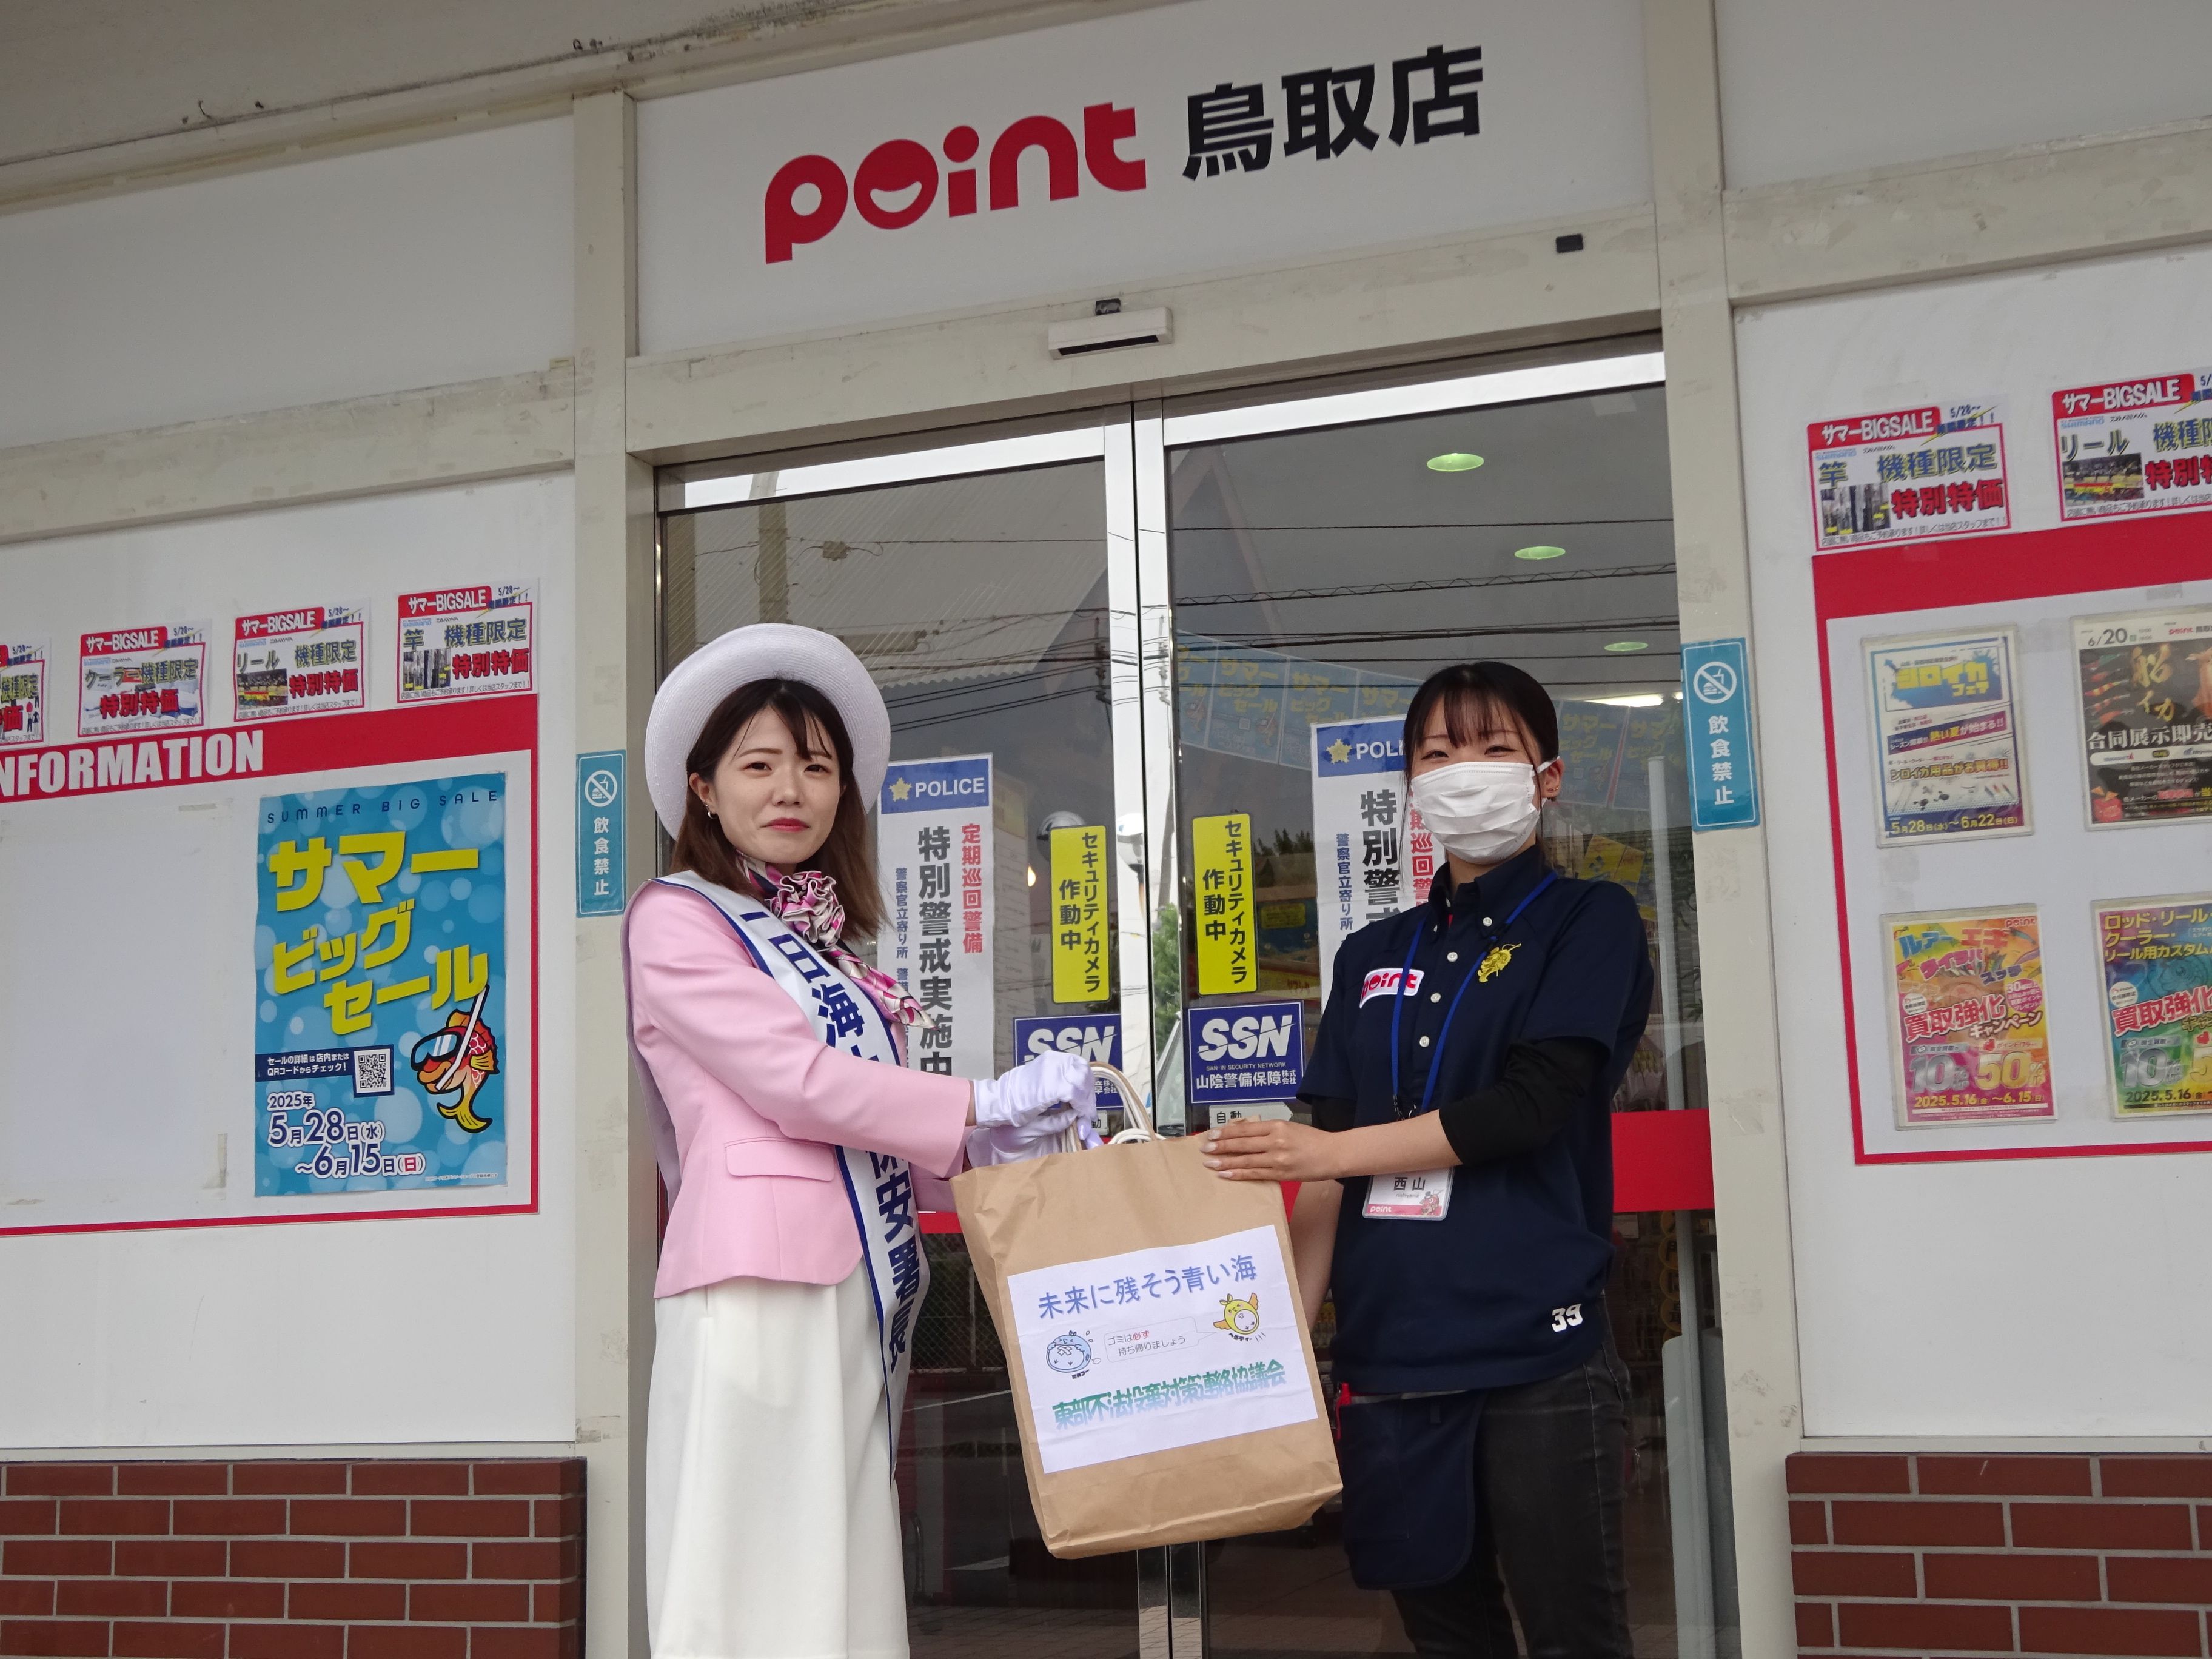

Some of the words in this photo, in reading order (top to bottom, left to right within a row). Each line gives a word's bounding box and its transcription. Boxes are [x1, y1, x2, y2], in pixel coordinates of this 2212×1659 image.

[765, 102, 1147, 264] point
[1182, 44, 1484, 181] 鳥取店
[1822, 410, 1934, 446] サマーBIGSALE
[2062, 429, 2130, 461] リール
[1877, 443, 1997, 483] 機種限定
[1891, 478, 2005, 520] 特別特価
[407, 589, 487, 614] サマーBIGSALE
[86, 629, 159, 653] サマーBIGSALE
[241, 611, 316, 637] サマーBIGSALE
[444, 618, 528, 648] 機種限定
[237, 649, 280, 674] リール
[295, 639, 357, 668] 機種限定
[452, 648, 529, 680] 特別特価
[289, 668, 358, 699] 特別特価
[99, 688, 181, 719] 特別特価
[1356, 739, 1404, 760] POLI
[1708, 714, 1734, 806] 飲食禁止
[915, 777, 985, 798] POLICE
[267, 803, 361, 824] SUMMER
[382, 798, 421, 812] BIG
[439, 789, 498, 806] SALE
[269, 830, 479, 912] サマー
[593, 816, 610, 896] 飲食禁止
[961, 823, 983, 954] 定期巡回警備
[1336, 833, 1353, 931] 警察官立寄り所
[896, 868, 908, 959] 警察官立寄り所
[1059, 879, 1081, 951] 作動中
[1082, 832, 1101, 993] セキュリティカメラ
[1202, 868, 1227, 941] 作動中
[1225, 820, 1247, 984] セキュリティカメラ
[272, 899, 415, 994] ビッグ
[2105, 943, 2212, 963] リール用カスタム
[324, 944, 489, 1036] セール
[1904, 994, 2008, 1044] 買取強化
[1969, 1010, 2043, 1039] キャンペーン
[1198, 1014, 1295, 1062] SSN
[269, 1093, 313, 1109] 2025年
[269, 1110, 384, 1145] 5月28日(水)
[1393, 1176, 1426, 1191] 西山
[1037, 1254, 1257, 1320] 未来に残そう青い海
[1551, 1303, 1584, 1333] 39
[1107, 1330, 1150, 1346] ゴミは必ず
[1118, 1335, 1186, 1357] 持ち帰りましょう
